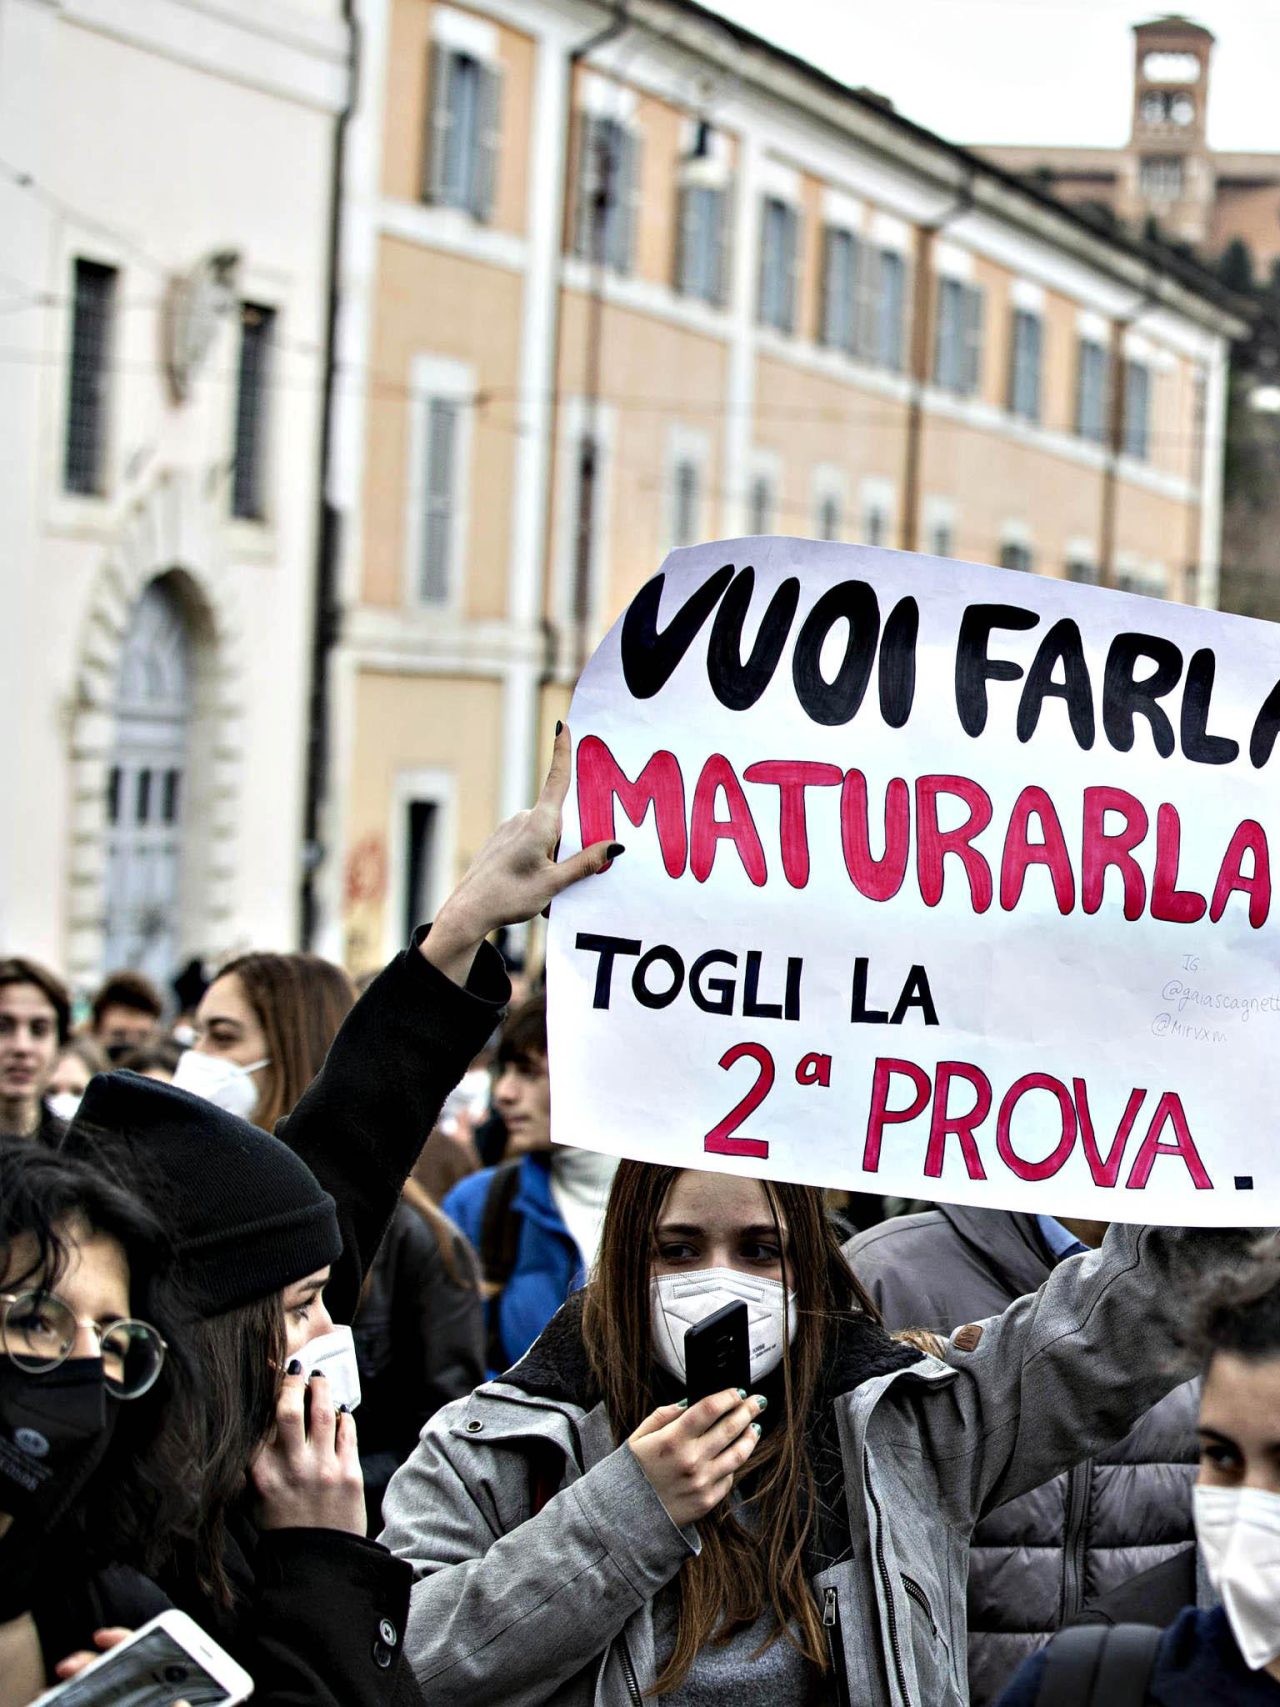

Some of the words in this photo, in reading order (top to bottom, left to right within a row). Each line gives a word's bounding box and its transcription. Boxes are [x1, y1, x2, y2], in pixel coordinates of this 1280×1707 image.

[620, 563, 920, 729] VUOI
[575, 932, 804, 1022] TOGLI
[850, 957, 940, 1026] LA
[862, 1056, 1254, 1191] PROVA.
